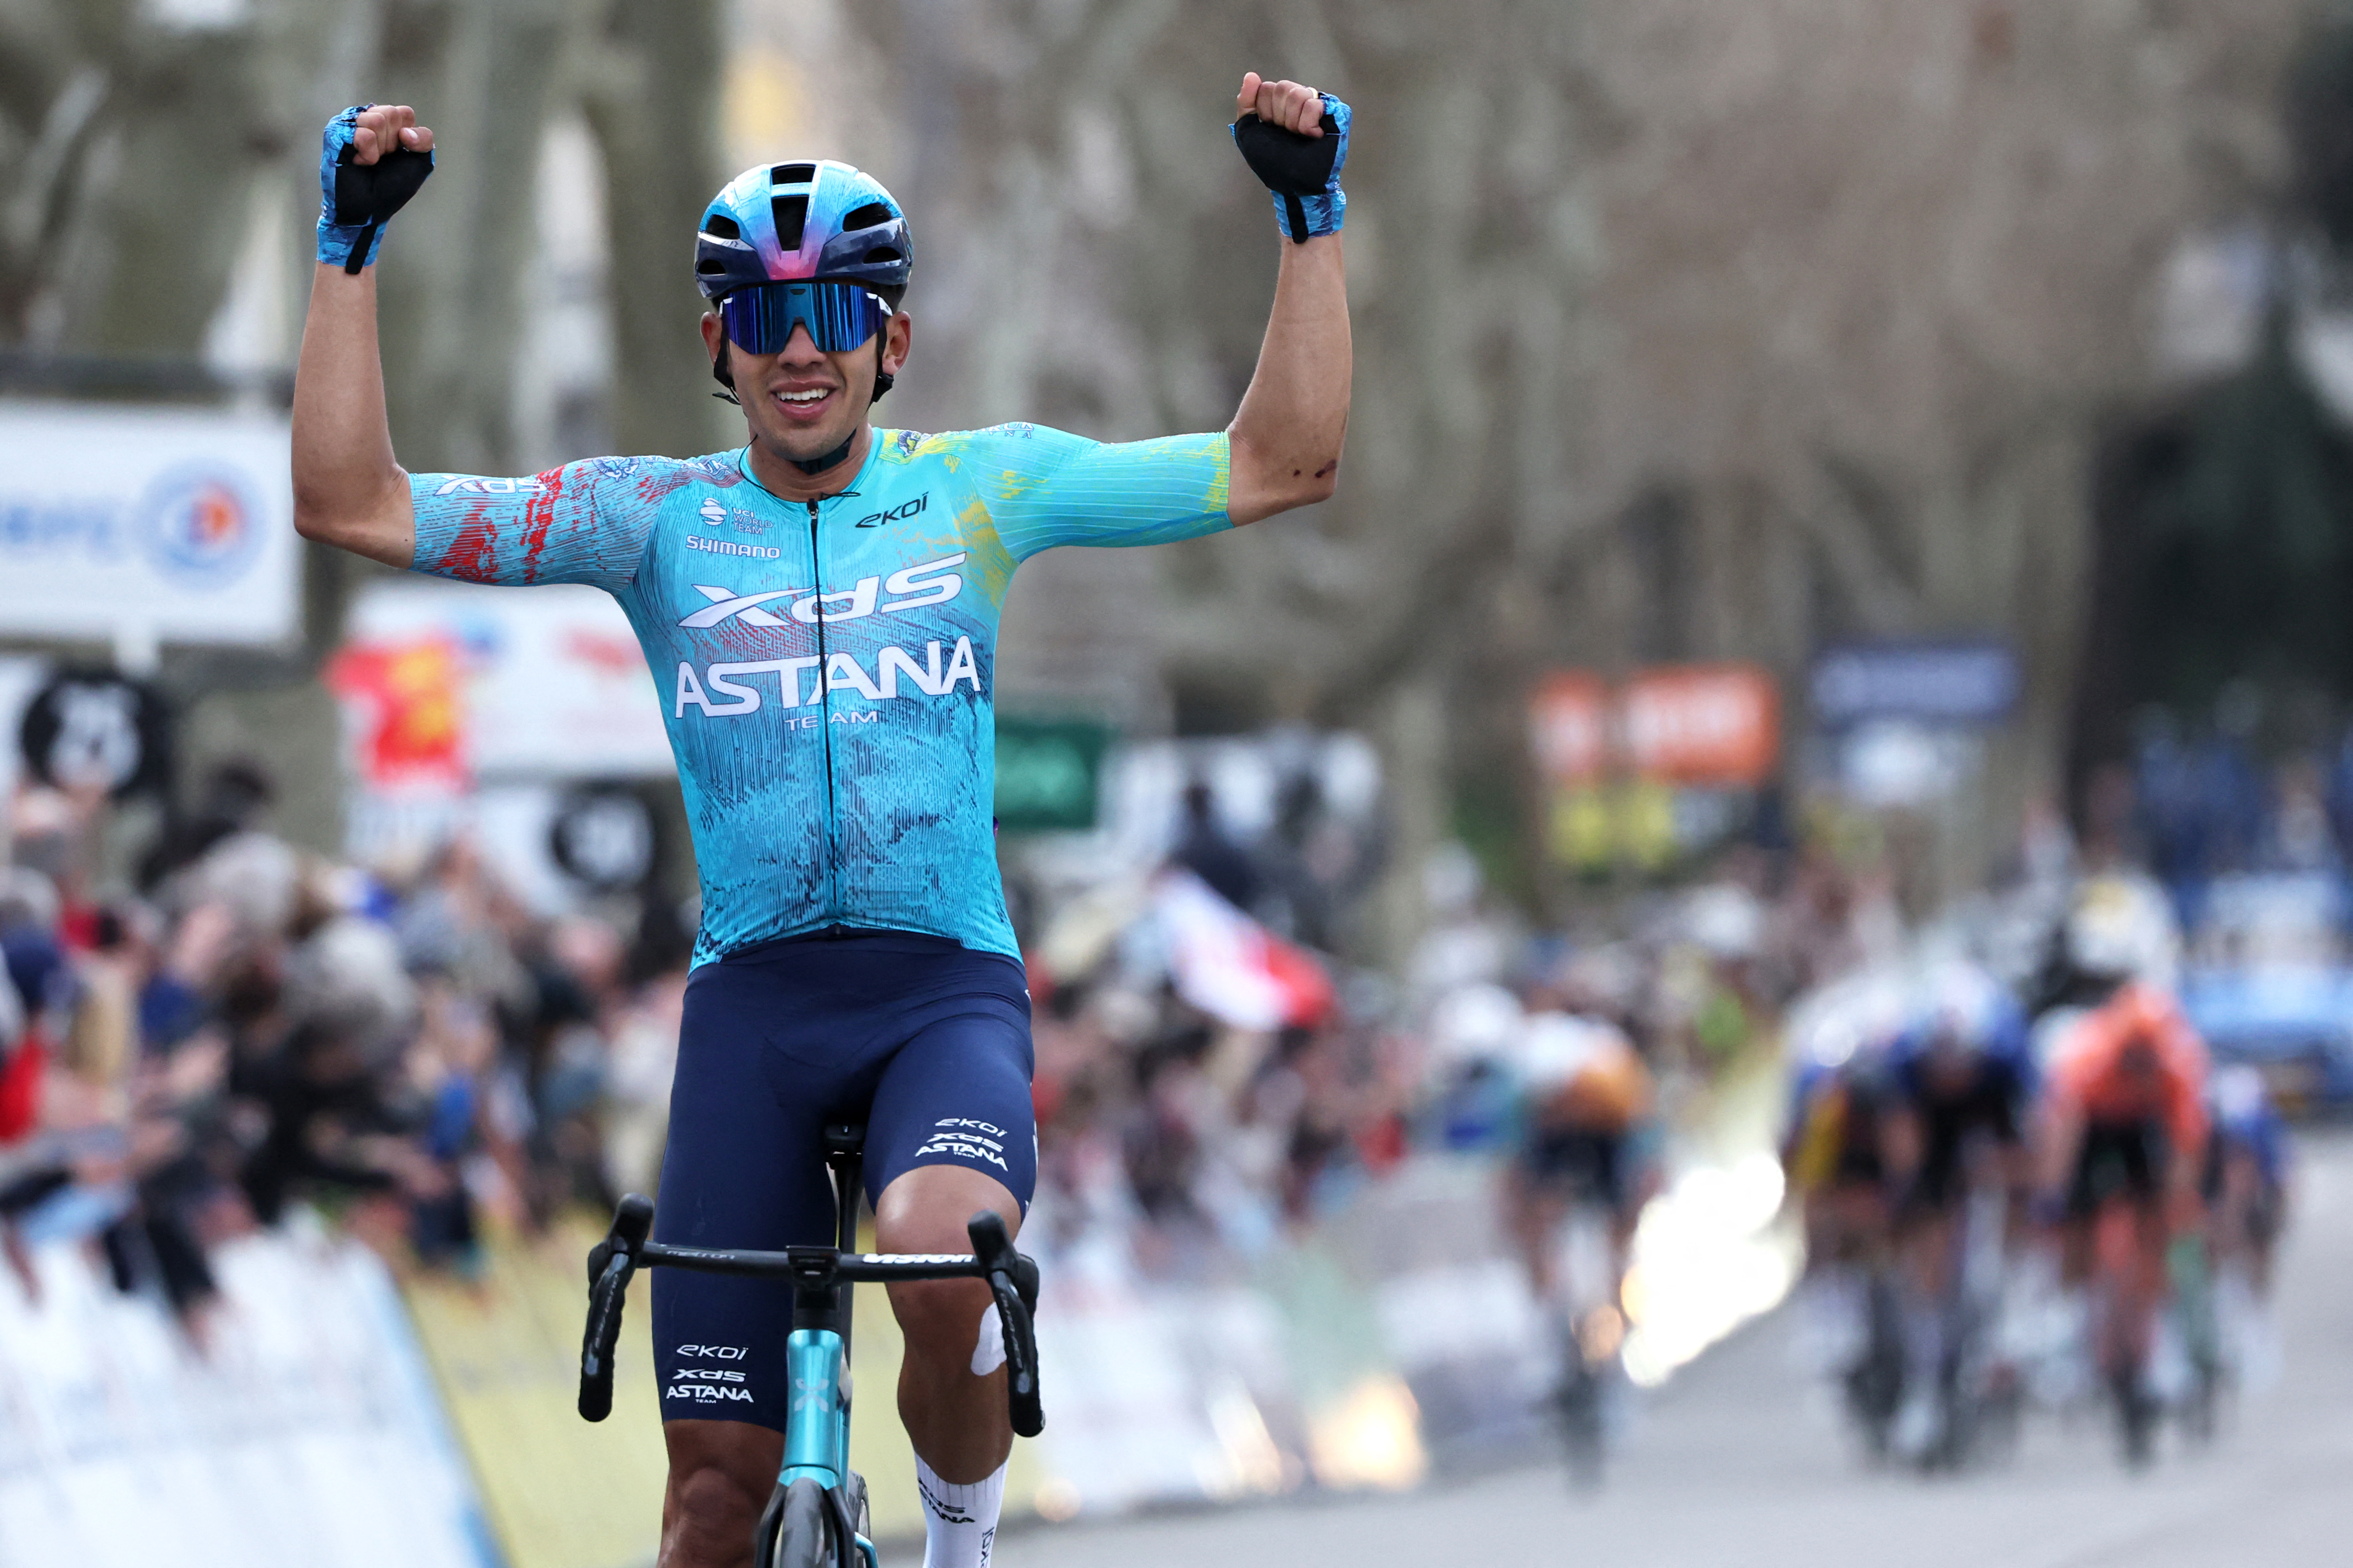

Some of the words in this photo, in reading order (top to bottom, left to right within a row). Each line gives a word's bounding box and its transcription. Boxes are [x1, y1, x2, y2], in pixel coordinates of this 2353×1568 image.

[733, 507, 754, 518] UCI
[733, 514, 774, 528] WORLD
[733, 522, 763, 535] TEAM
[685, 535, 781, 558] SHIMANO
[675, 634, 981, 719] ASTANA
[785, 711, 878, 731] TEAM
[915, 1142, 1009, 1172] ASTANA
[666, 1384, 754, 1403] ASTANA
